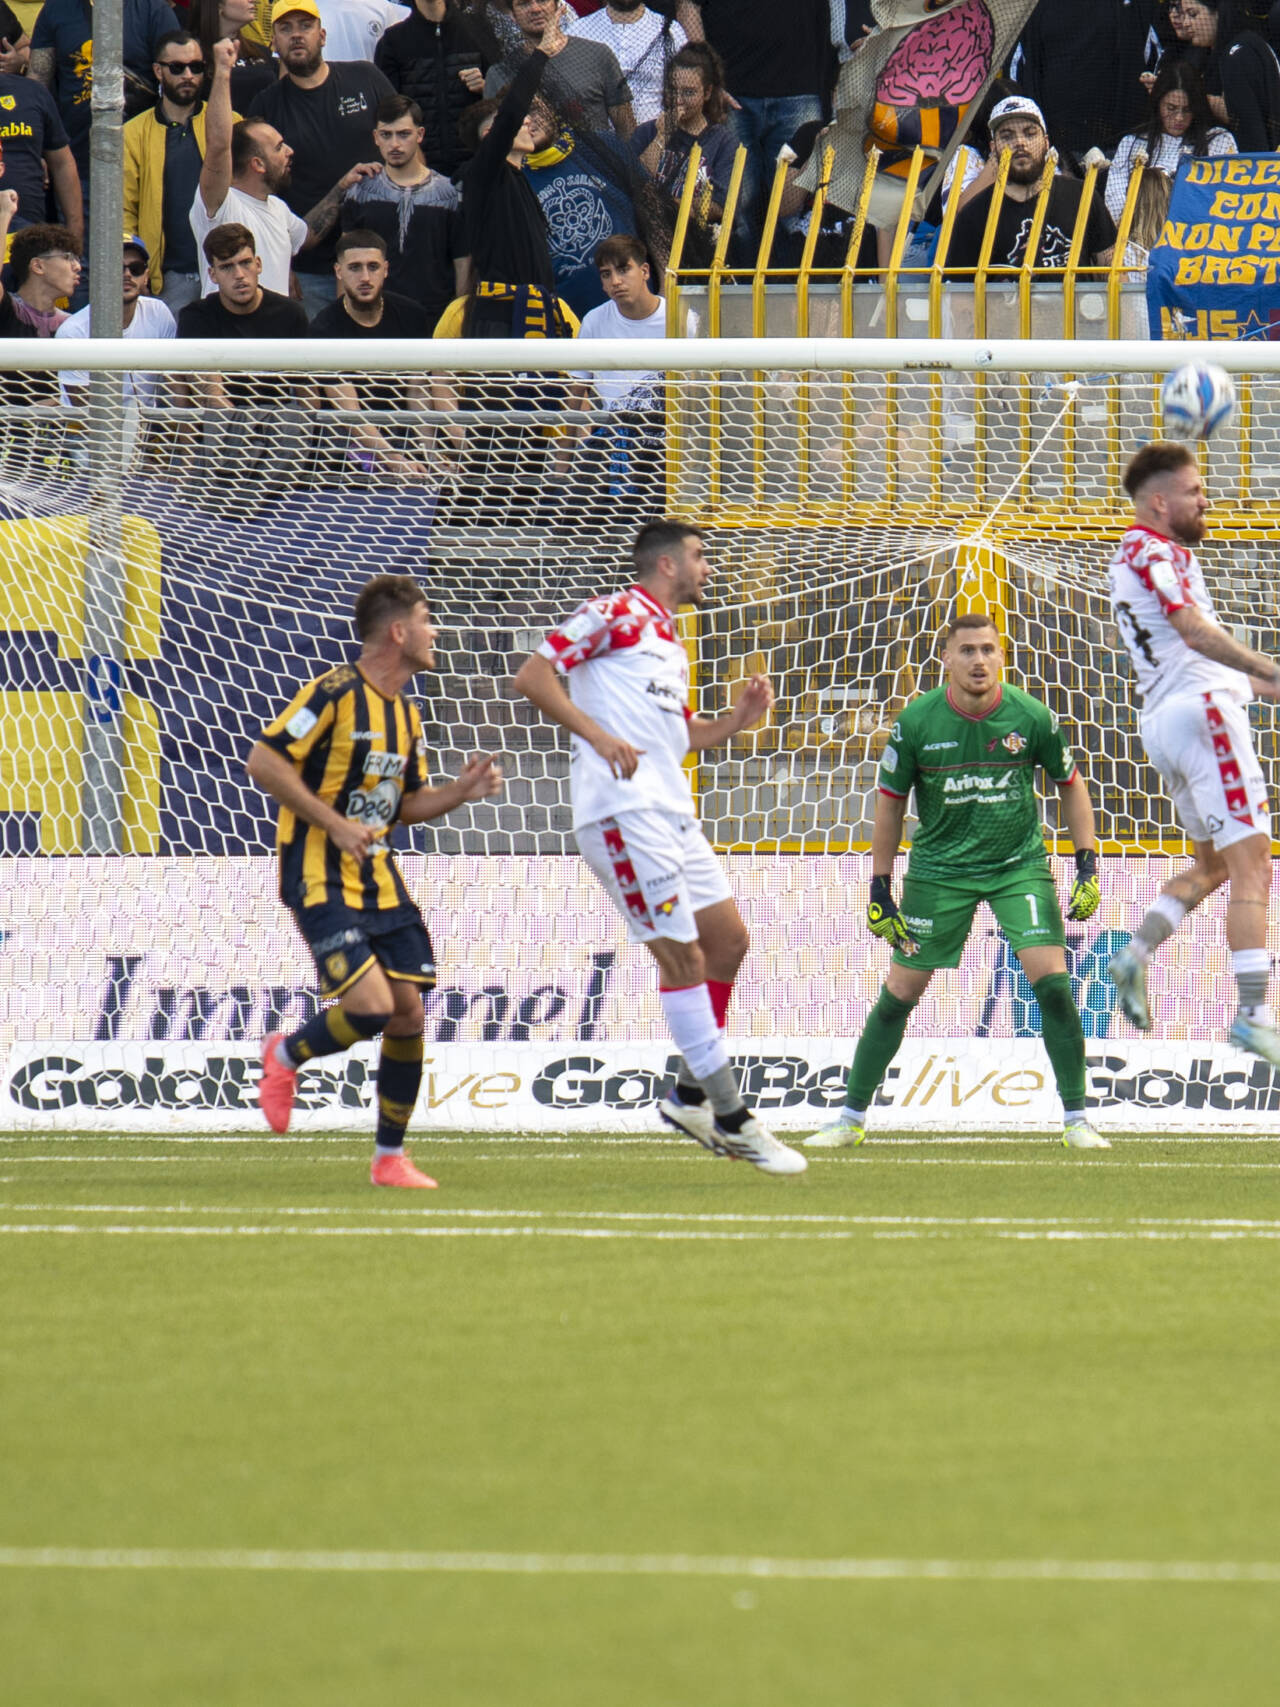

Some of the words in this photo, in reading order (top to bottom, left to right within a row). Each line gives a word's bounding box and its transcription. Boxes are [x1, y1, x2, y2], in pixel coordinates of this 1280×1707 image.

[1157, 222, 1246, 251] NON
[943, 773, 995, 793] Arinox
[1025, 893, 1039, 927] 1
[901, 1054, 1045, 1107] live
